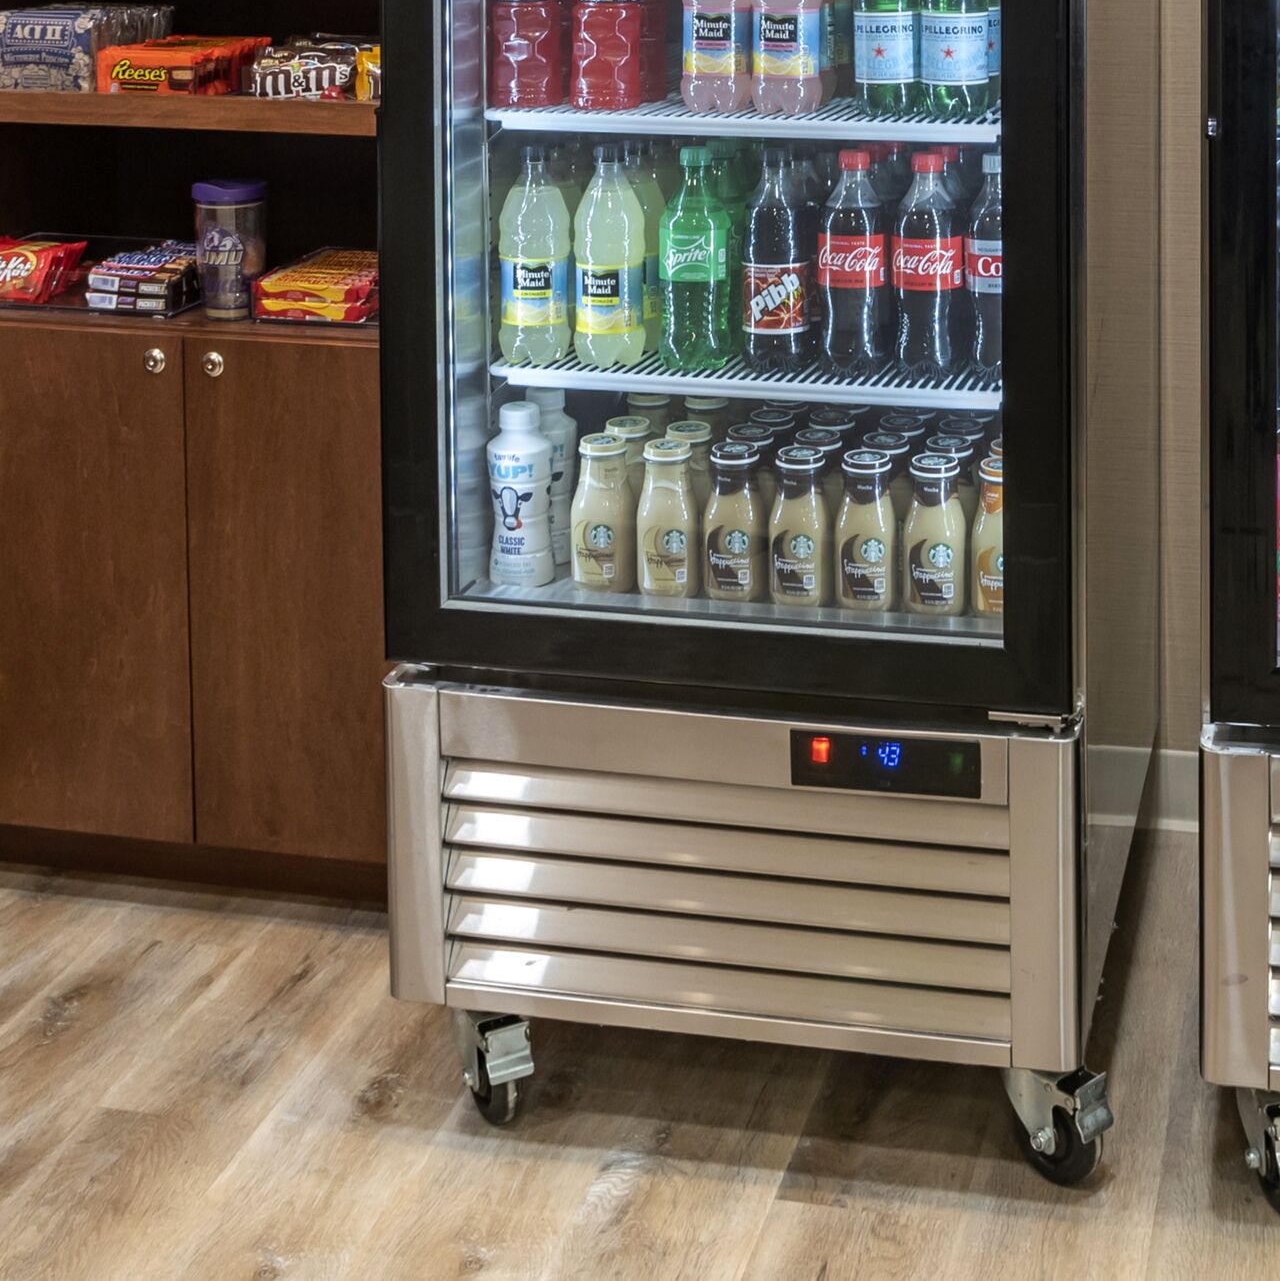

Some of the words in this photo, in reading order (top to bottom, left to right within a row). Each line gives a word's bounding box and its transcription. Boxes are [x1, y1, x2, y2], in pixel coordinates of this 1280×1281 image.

[695, 19, 729, 30] Minute
[763, 20, 795, 32] Minute
[13, 25, 42, 39] ACT
[698, 28, 723, 39] Maid
[765, 29, 790, 40] Maid
[112, 58, 167, 81] Reese's
[203, 250, 244, 265] JMU
[668, 246, 708, 265] Sprite
[819, 246, 881, 272] Coca-Cola
[893, 248, 956, 276] Coca-Cola
[516, 269, 550, 280] Minute
[520, 278, 545, 288] Maid
[584, 276, 616, 287] Minute
[588, 285, 611, 295] Maid
[750, 272, 801, 321] Pibb
[499, 535, 525, 546] CLASSIC
[500, 546, 522, 555] WHITE
[878, 746, 900, 766] 43
